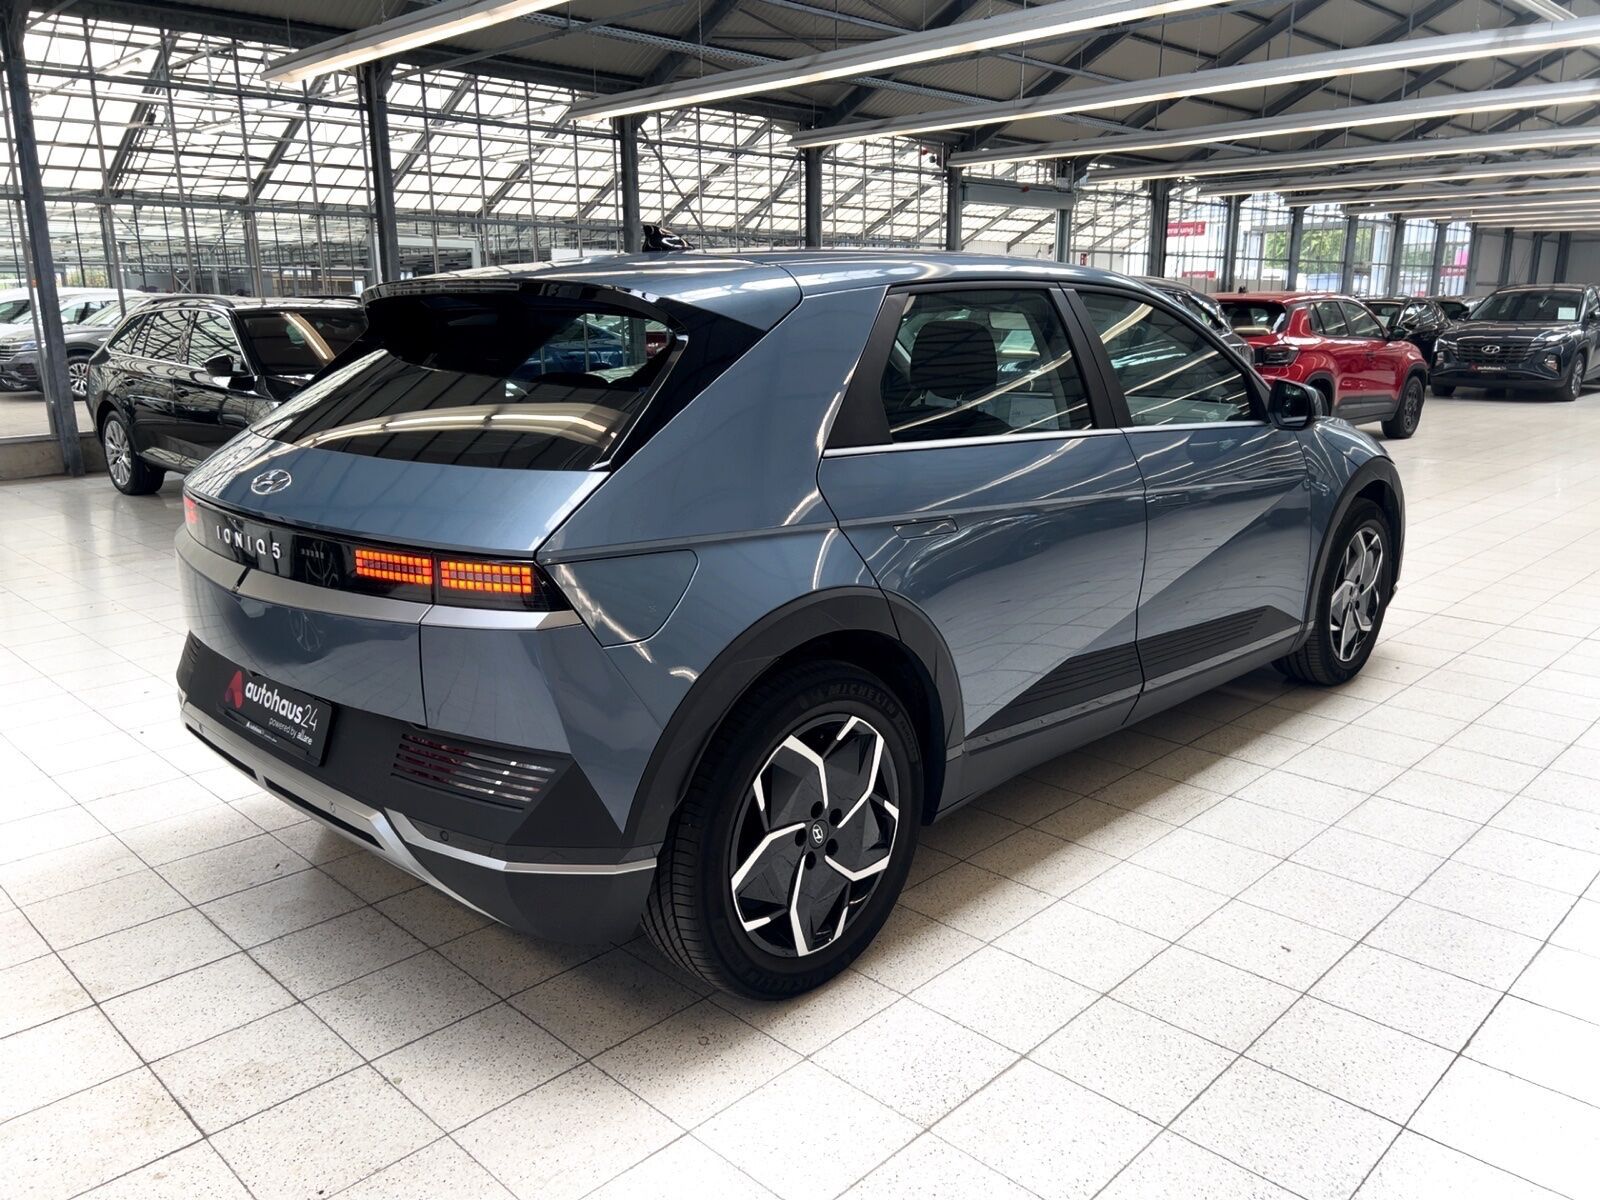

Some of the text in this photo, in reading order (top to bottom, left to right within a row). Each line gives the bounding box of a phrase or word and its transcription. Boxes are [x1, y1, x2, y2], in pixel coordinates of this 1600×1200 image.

[216, 525, 267, 555] IONIQ
[272, 542, 281, 559] 5
[245, 681, 318, 731] autohaus24
[828, 683, 897, 714] MICHELIN
